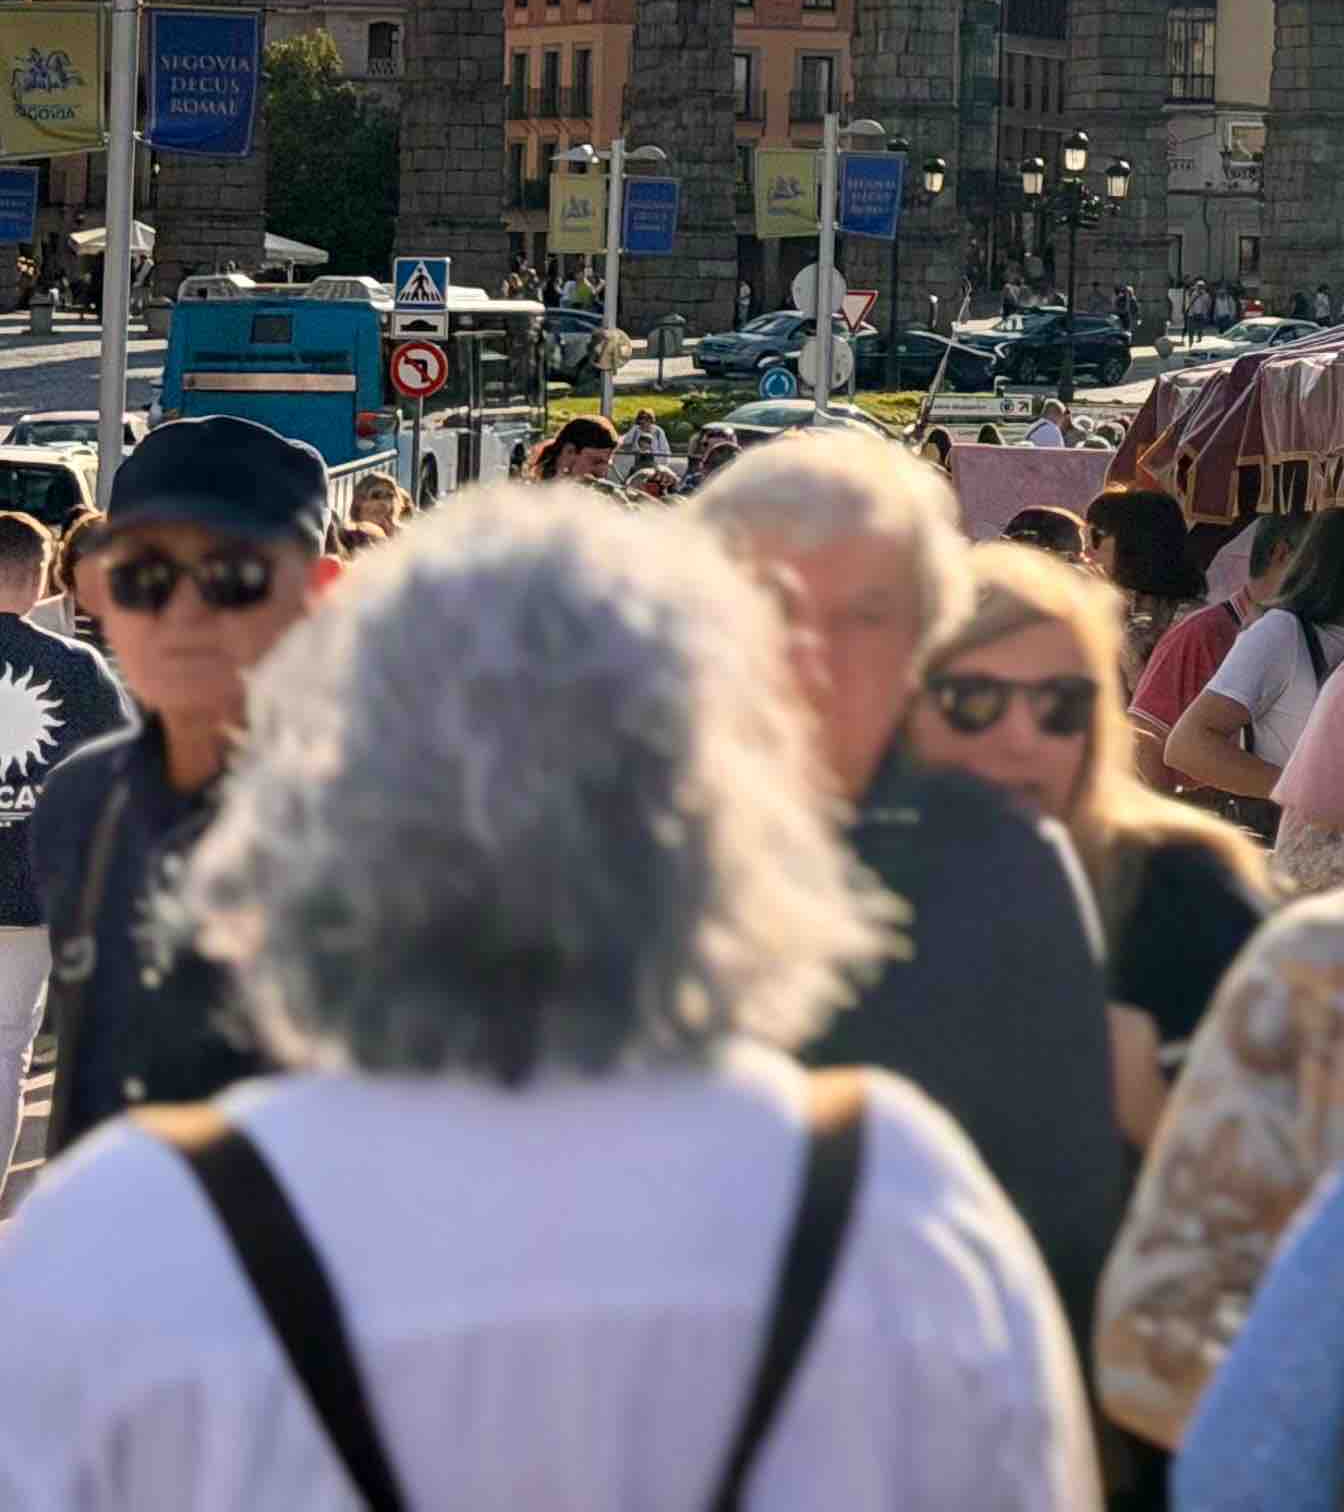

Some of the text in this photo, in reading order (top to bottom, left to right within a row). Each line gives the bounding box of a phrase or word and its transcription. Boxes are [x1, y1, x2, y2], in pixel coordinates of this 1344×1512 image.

[160, 56, 250, 72] SEGOVIA
[170, 76, 240, 94] DECUS
[0, 785, 44, 808] CA
